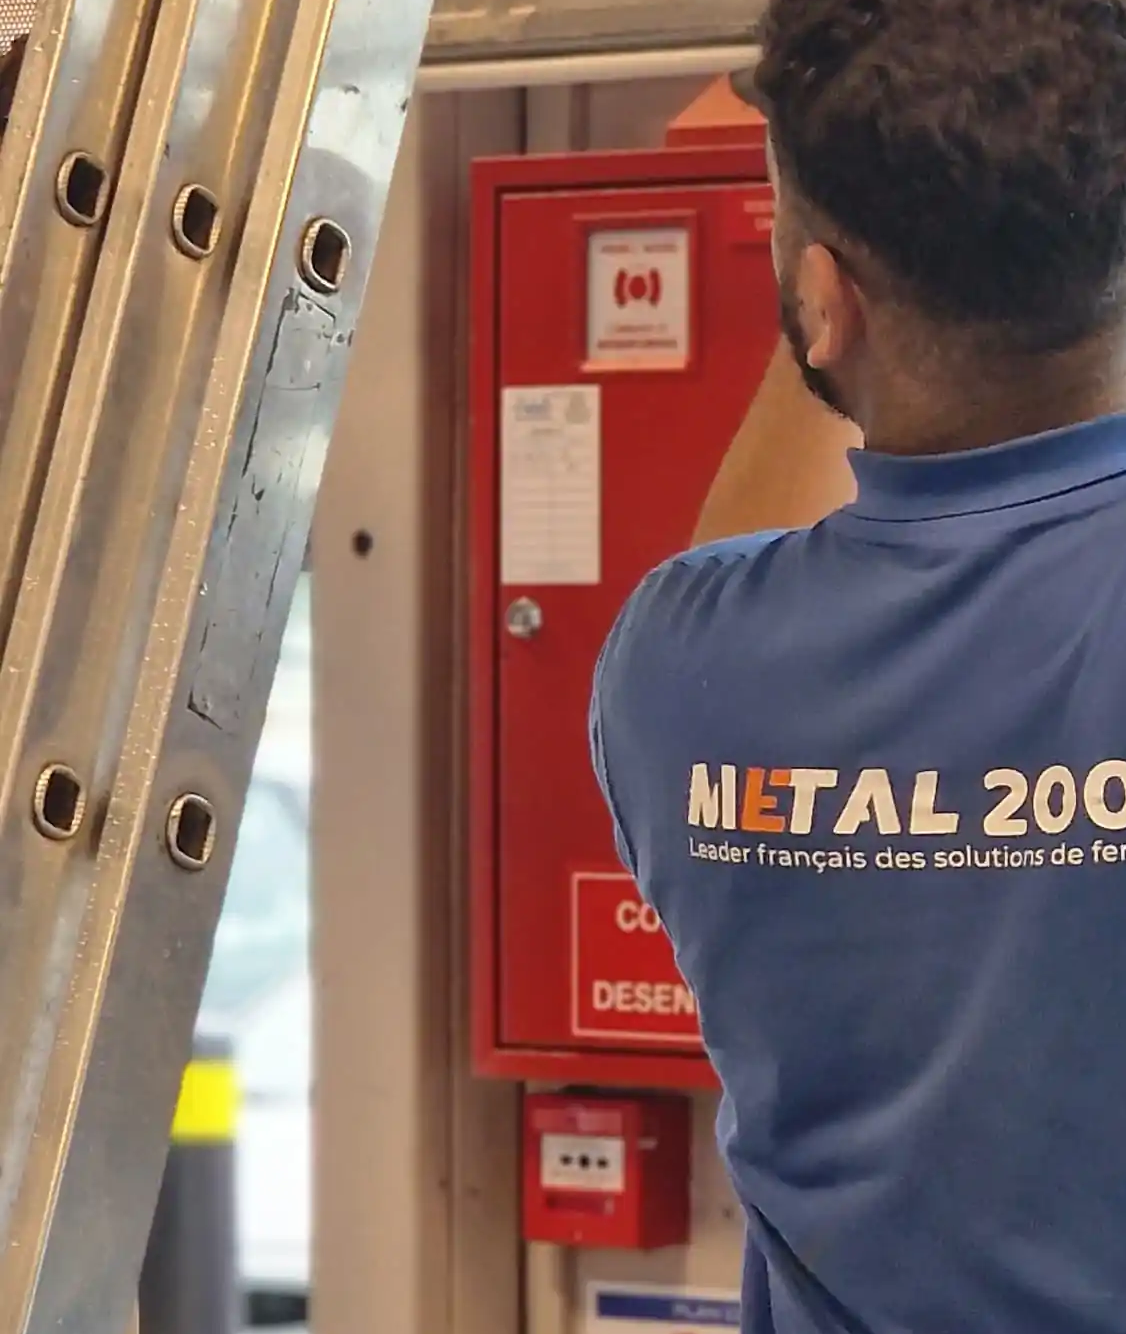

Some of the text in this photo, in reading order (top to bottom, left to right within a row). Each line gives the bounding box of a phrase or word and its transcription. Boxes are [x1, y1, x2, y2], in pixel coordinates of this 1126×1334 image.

[688, 762, 960, 836] METAL
[688, 836, 751, 864] Leader
[756, 843, 867, 873] français
[875, 846, 927, 869] des
[933, 844, 1044, 869] solutions
[1050, 842, 1085, 866] de
